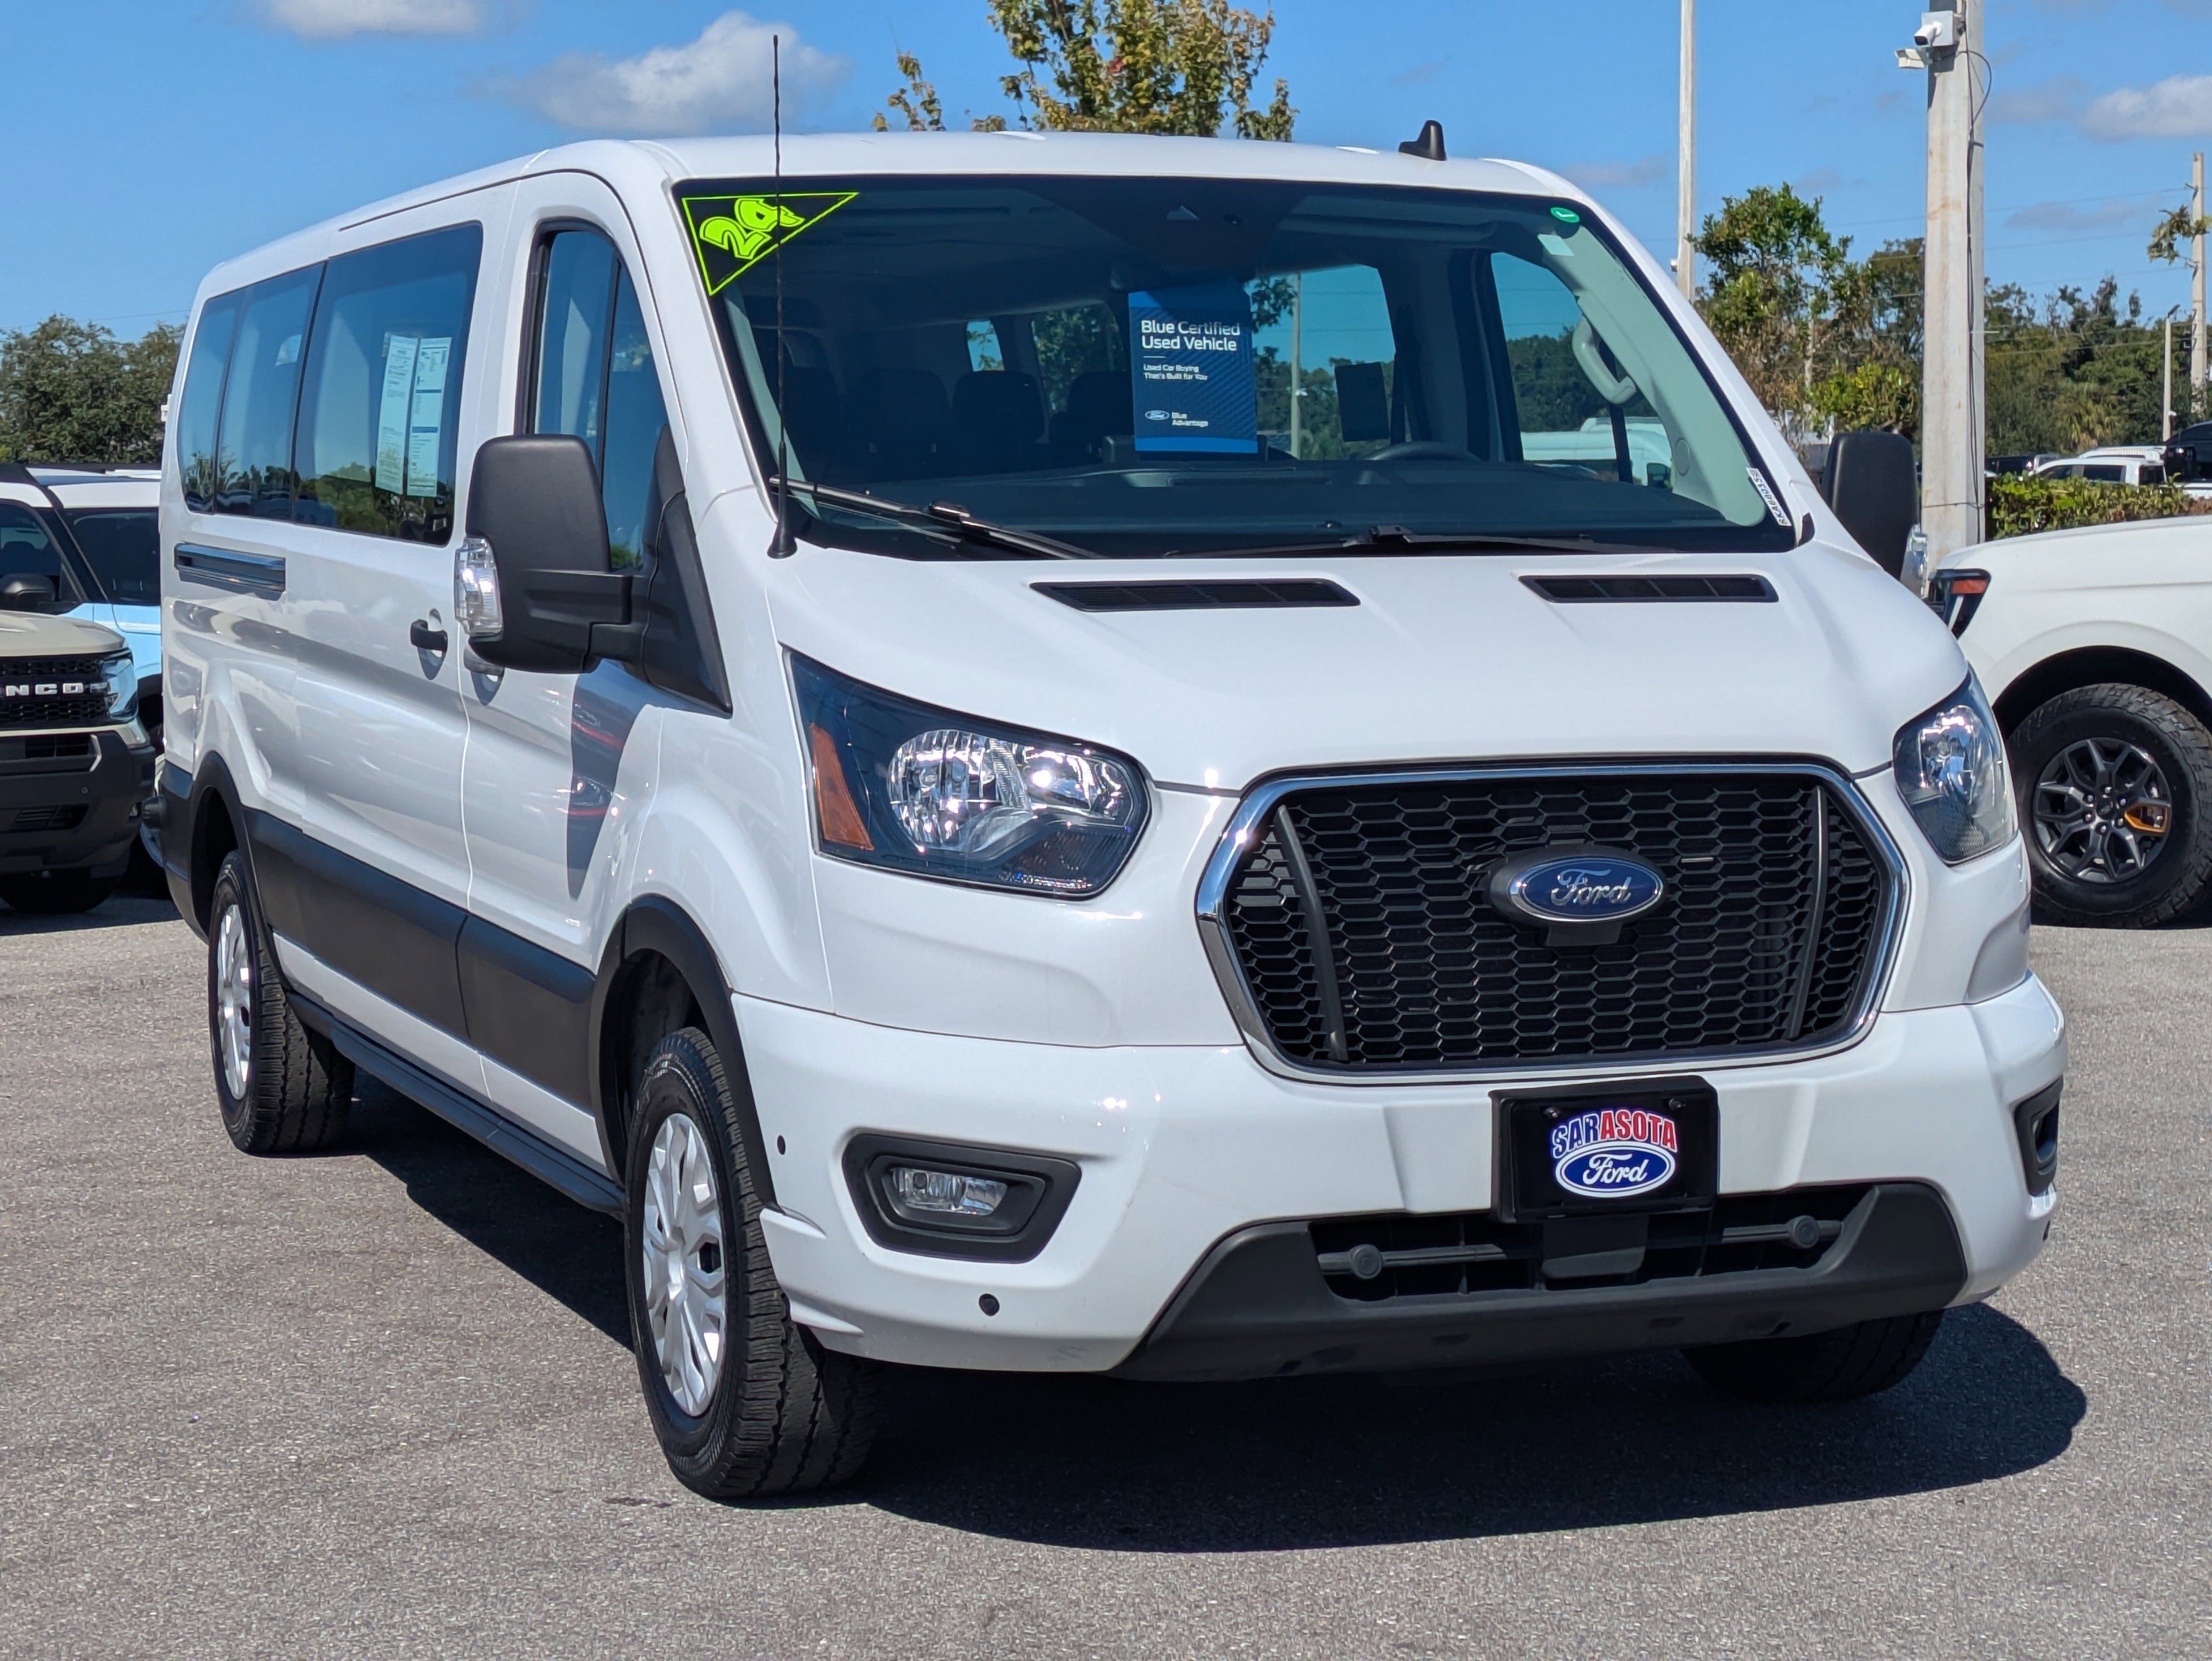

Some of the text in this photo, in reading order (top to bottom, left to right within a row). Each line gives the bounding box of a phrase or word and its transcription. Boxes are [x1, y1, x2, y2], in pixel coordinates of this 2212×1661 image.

[1141, 319, 1241, 336] Blue Certified
[1142, 335, 1237, 351] Used Vehicle
[1551, 868, 1632, 906] Ford
[1552, 1108, 1678, 1159] SARASOTA
[1582, 1153, 1650, 1185] Ford
